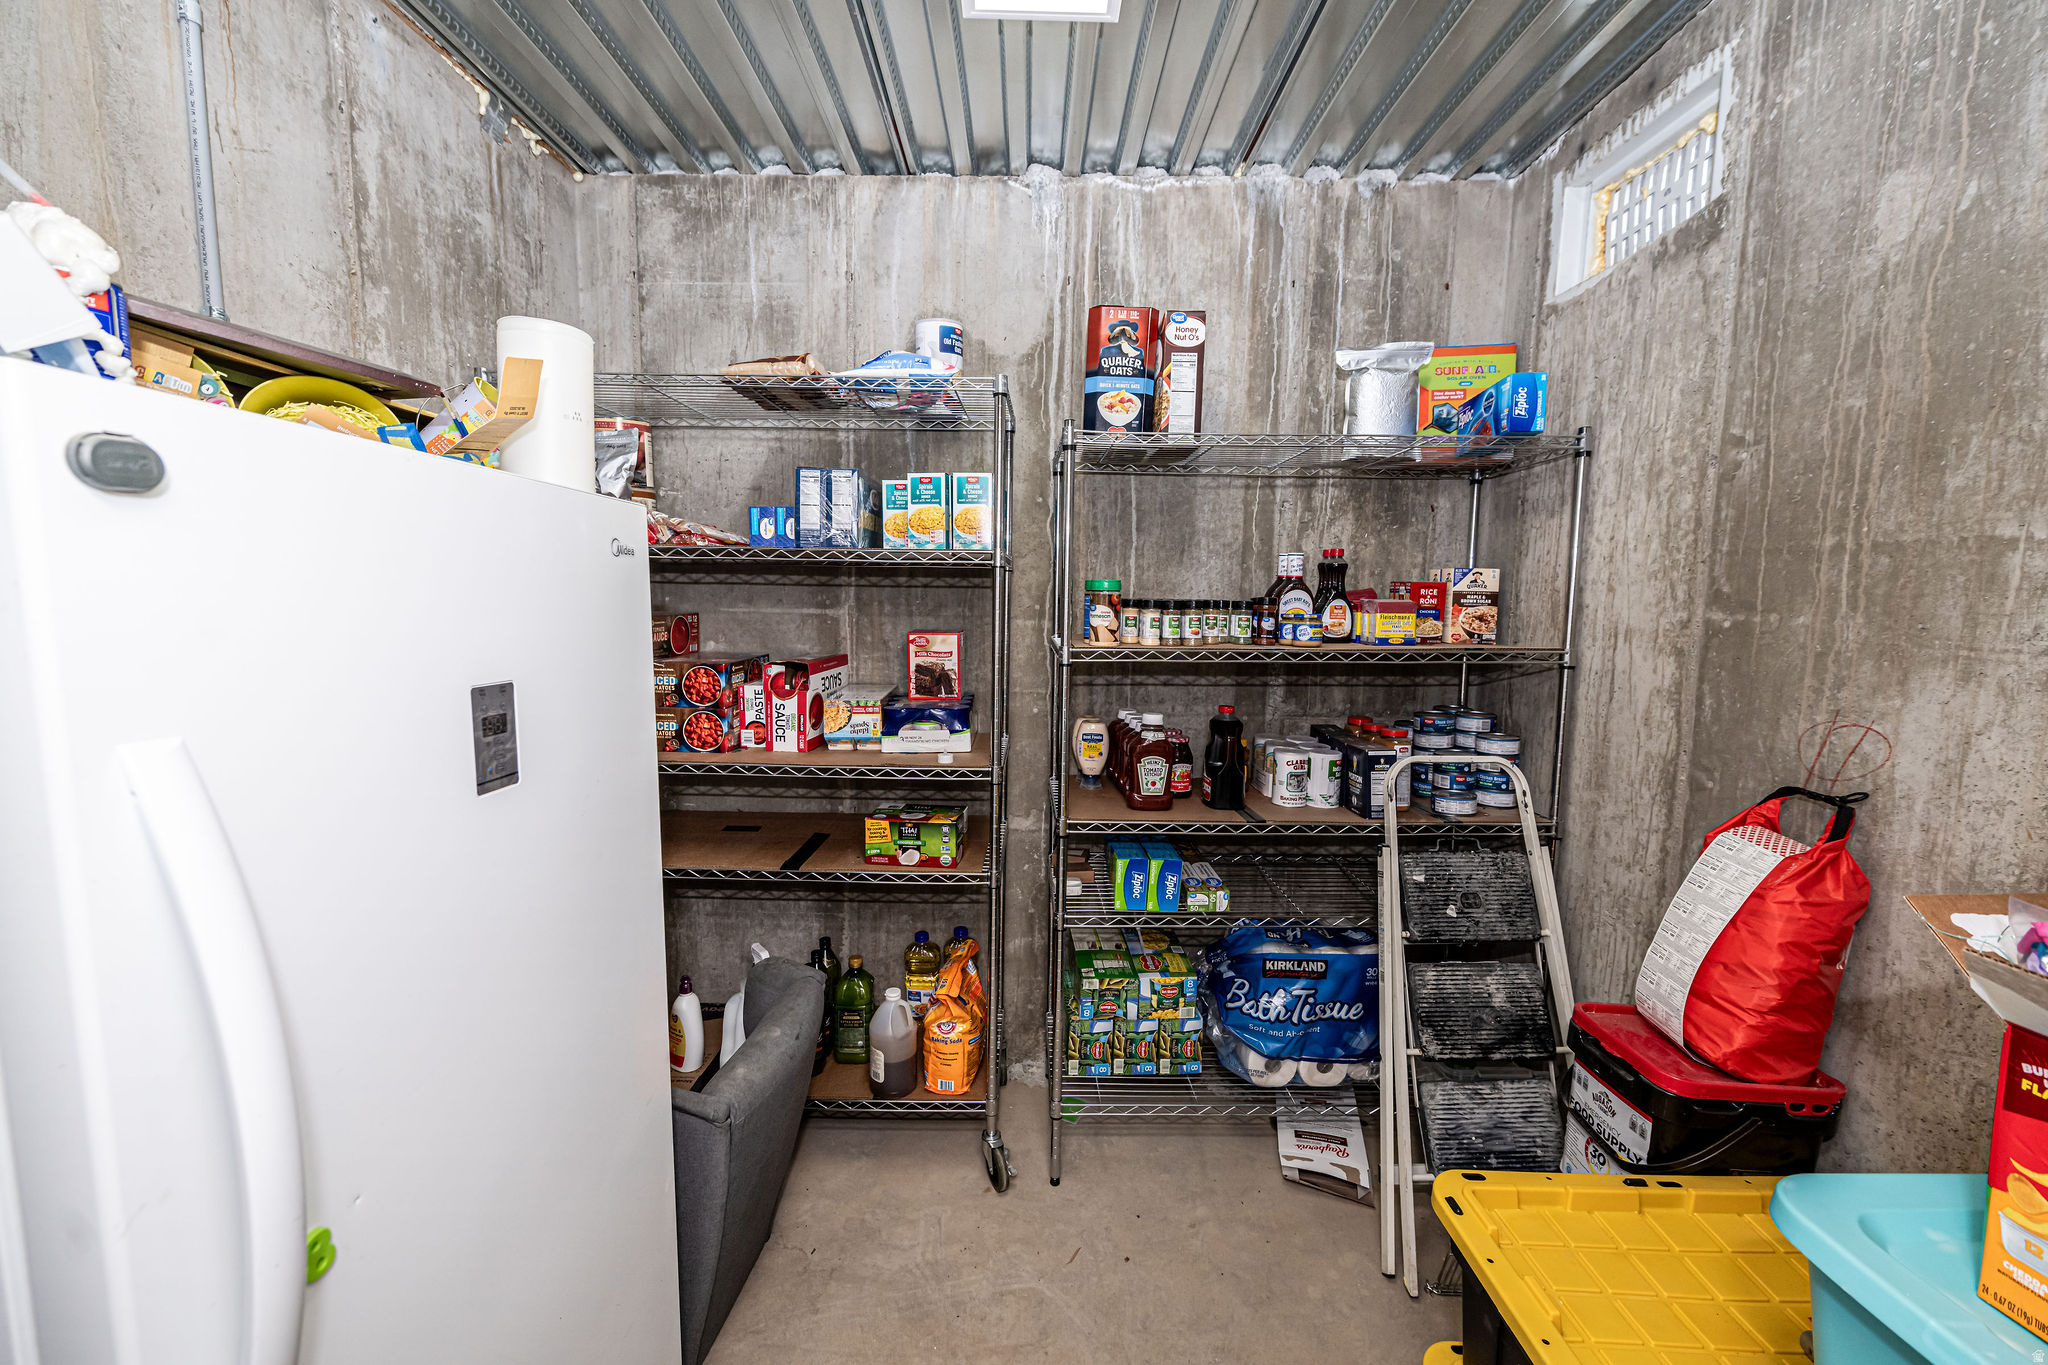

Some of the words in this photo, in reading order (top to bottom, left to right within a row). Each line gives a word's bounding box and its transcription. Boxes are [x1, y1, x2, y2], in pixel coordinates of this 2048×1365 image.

[1175, 326, 1199, 334] Honey
[1101, 357, 1143, 370] QUAKER
[1109, 366, 1133, 376] OATS
[1435, 365, 1497, 376] SUNFLAIR
[1513, 387, 1529, 417] Ziploc
[1420, 588, 1438, 596] RICE
[1419, 597, 1437, 605] RONI
[654, 676, 677, 686] ICED
[821, 671, 842, 693] SAUCE
[755, 688, 764, 721] PASTE
[656, 721, 677, 731] CED
[775, 703, 786, 743] SAUCE
[1286, 759, 1306, 767] CLABB
[1131, 873, 1144, 899] Ziploc
[1165, 875, 1177, 900] Ziploc
[1210, 893, 1217, 903] 50
[1265, 960, 1326, 973] KIRKLAND
[1365, 968, 1378, 976] 30
[1187, 980, 1194, 988] 8
[1225, 978, 1292, 1022] Bath
[1289, 989, 1364, 1024] Tissue
[1083, 1009, 1090, 1017] 8
[1249, 1024, 1266, 1033] Soft
[931, 1036, 948, 1045] Baking
[1584, 1101, 1621, 1137] EMERGENCY
[1569, 1096, 1595, 1127] FOOD
[1595, 1122, 1643, 1165] SUPPLY
[1589, 1145, 1607, 1167] 30
[1590, 1158, 1603, 1171] DAY
[2024, 1239, 2044, 1260] 12
[1982, 1283, 1989, 1296] 24
[1993, 1291, 2007, 1307] 0.67
[2008, 1301, 2016, 1313] OZ
[2017, 1307, 2033, 1326] (19g)
